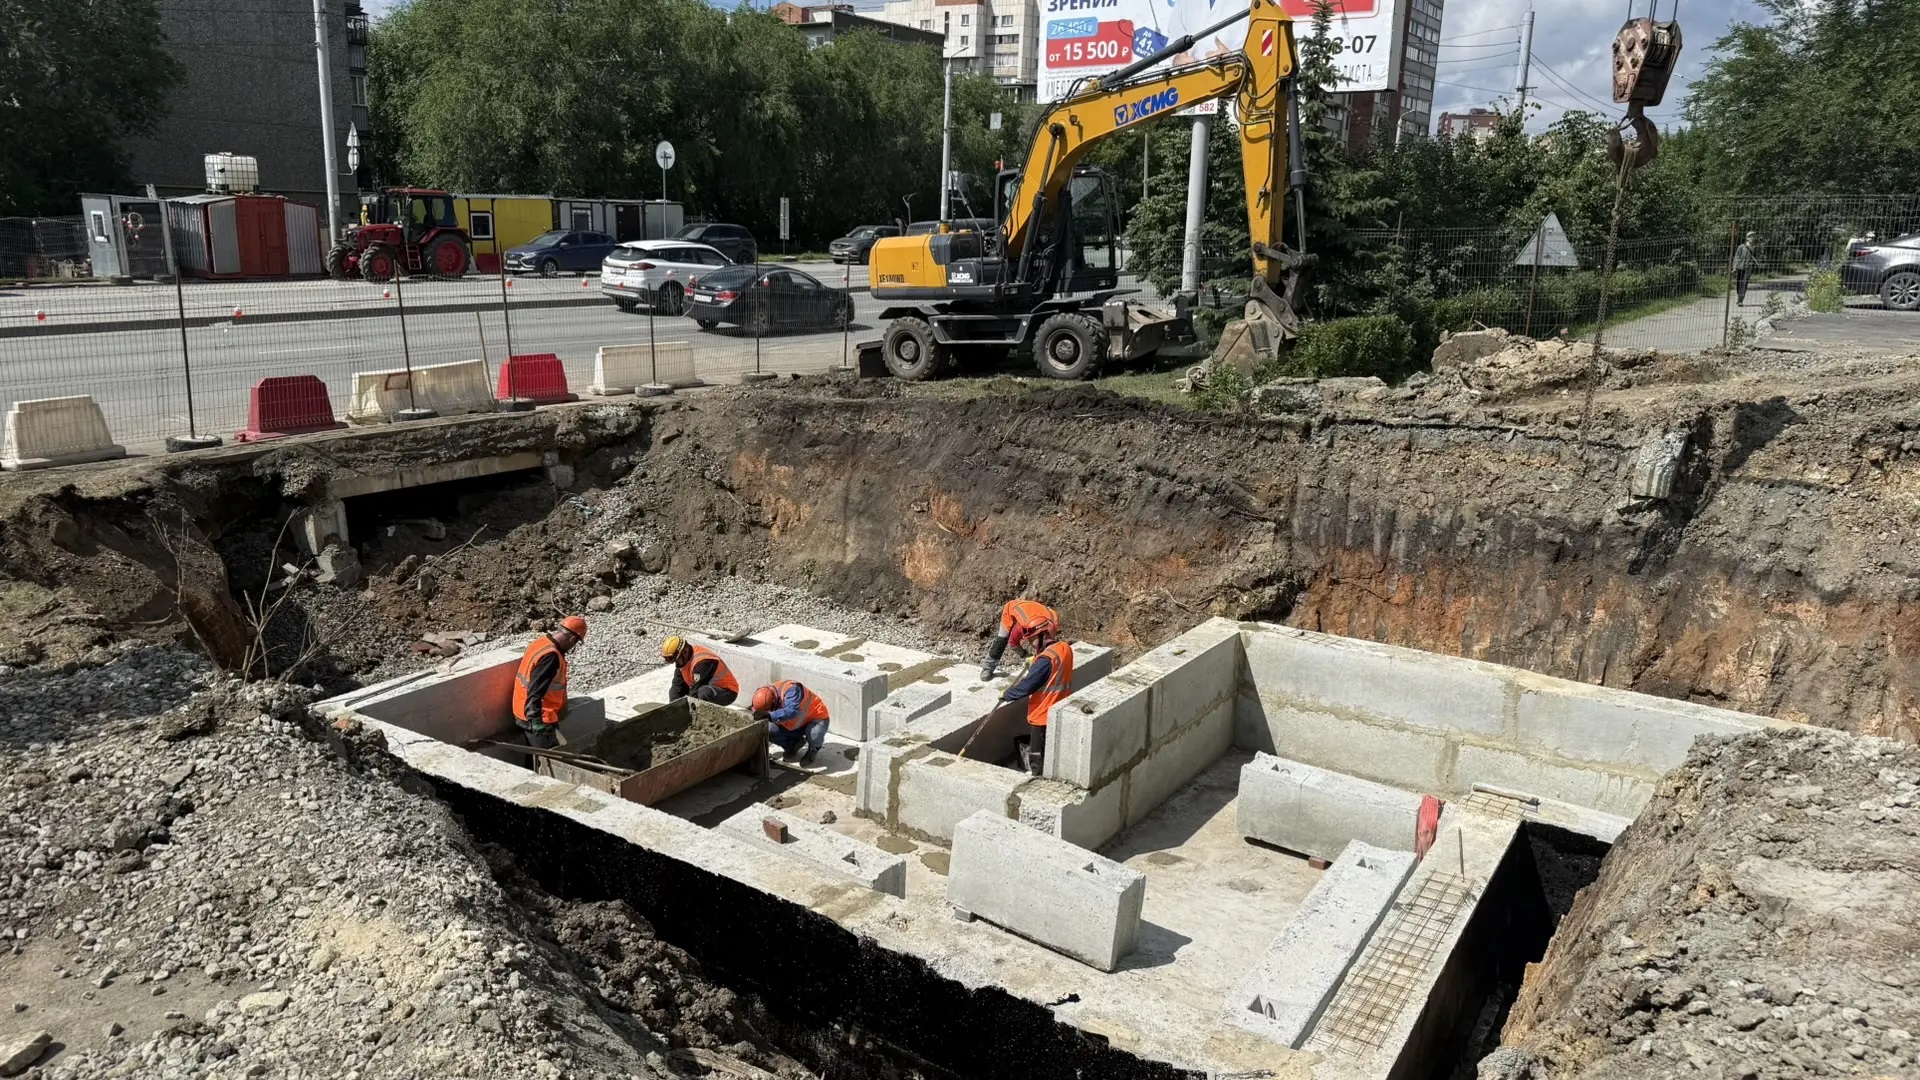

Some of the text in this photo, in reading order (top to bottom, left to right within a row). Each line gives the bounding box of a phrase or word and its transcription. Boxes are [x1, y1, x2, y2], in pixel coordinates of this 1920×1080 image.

[1063, 42, 1083, 60] 15
[1087, 40, 1118, 59] 500
[1129, 87, 1179, 121] XCMG
[1199, 103, 1215, 112] 582
